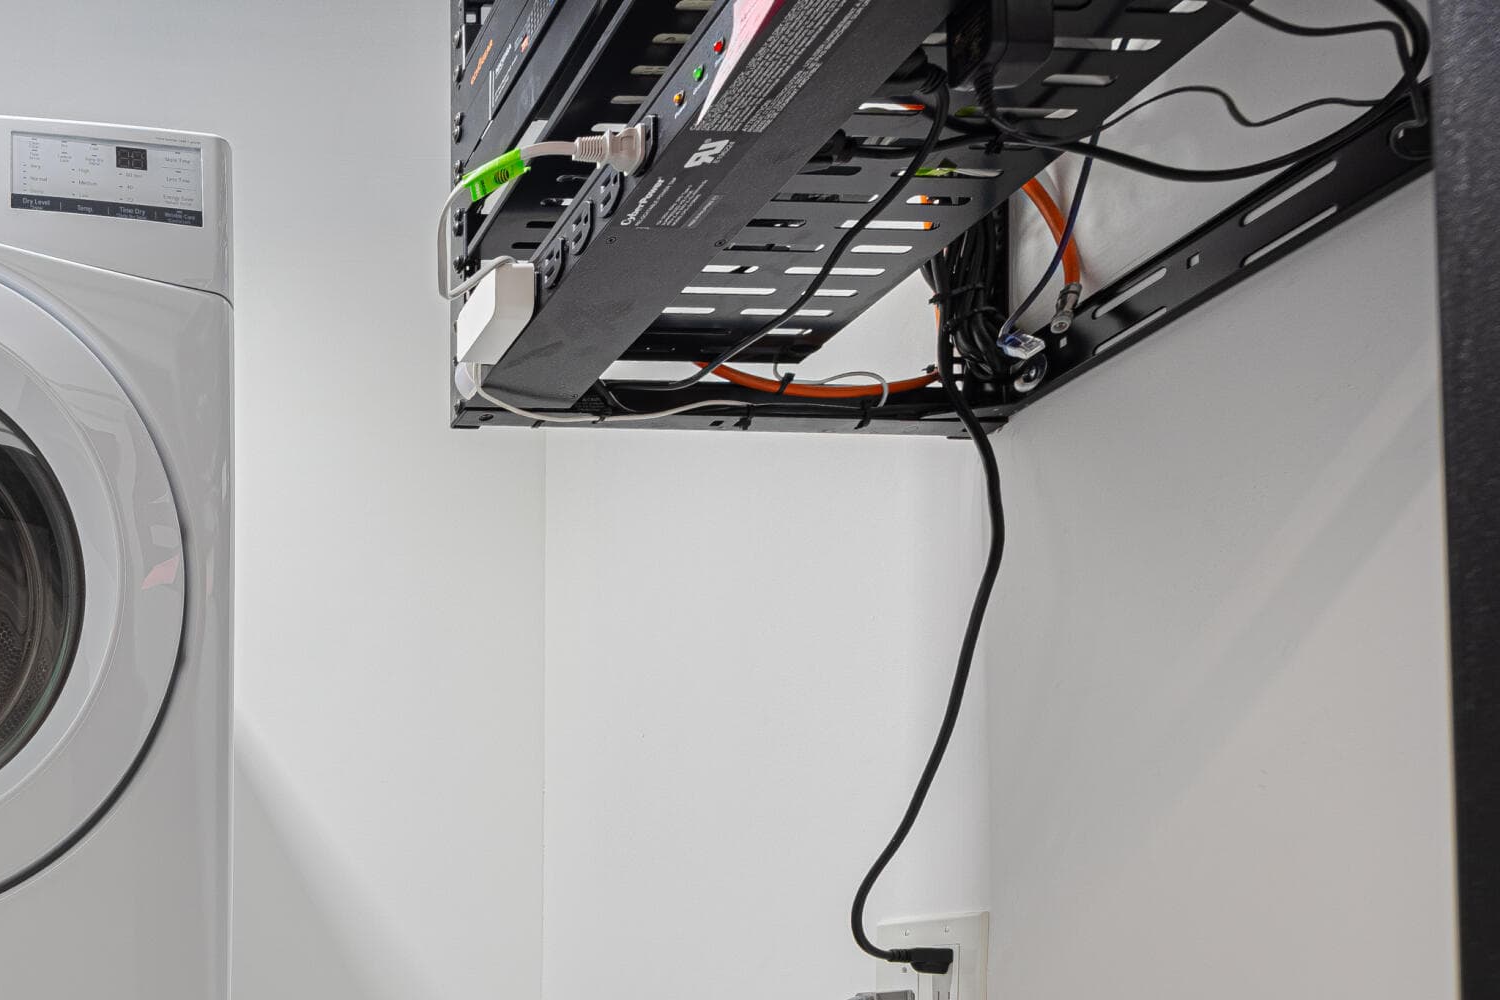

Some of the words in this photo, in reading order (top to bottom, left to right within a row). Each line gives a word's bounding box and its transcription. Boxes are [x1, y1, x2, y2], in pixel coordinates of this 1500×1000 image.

[22, 198, 33, 206] Dry
[620, 177, 664, 226] CyberPower
[135, 208, 146, 216] Dry
